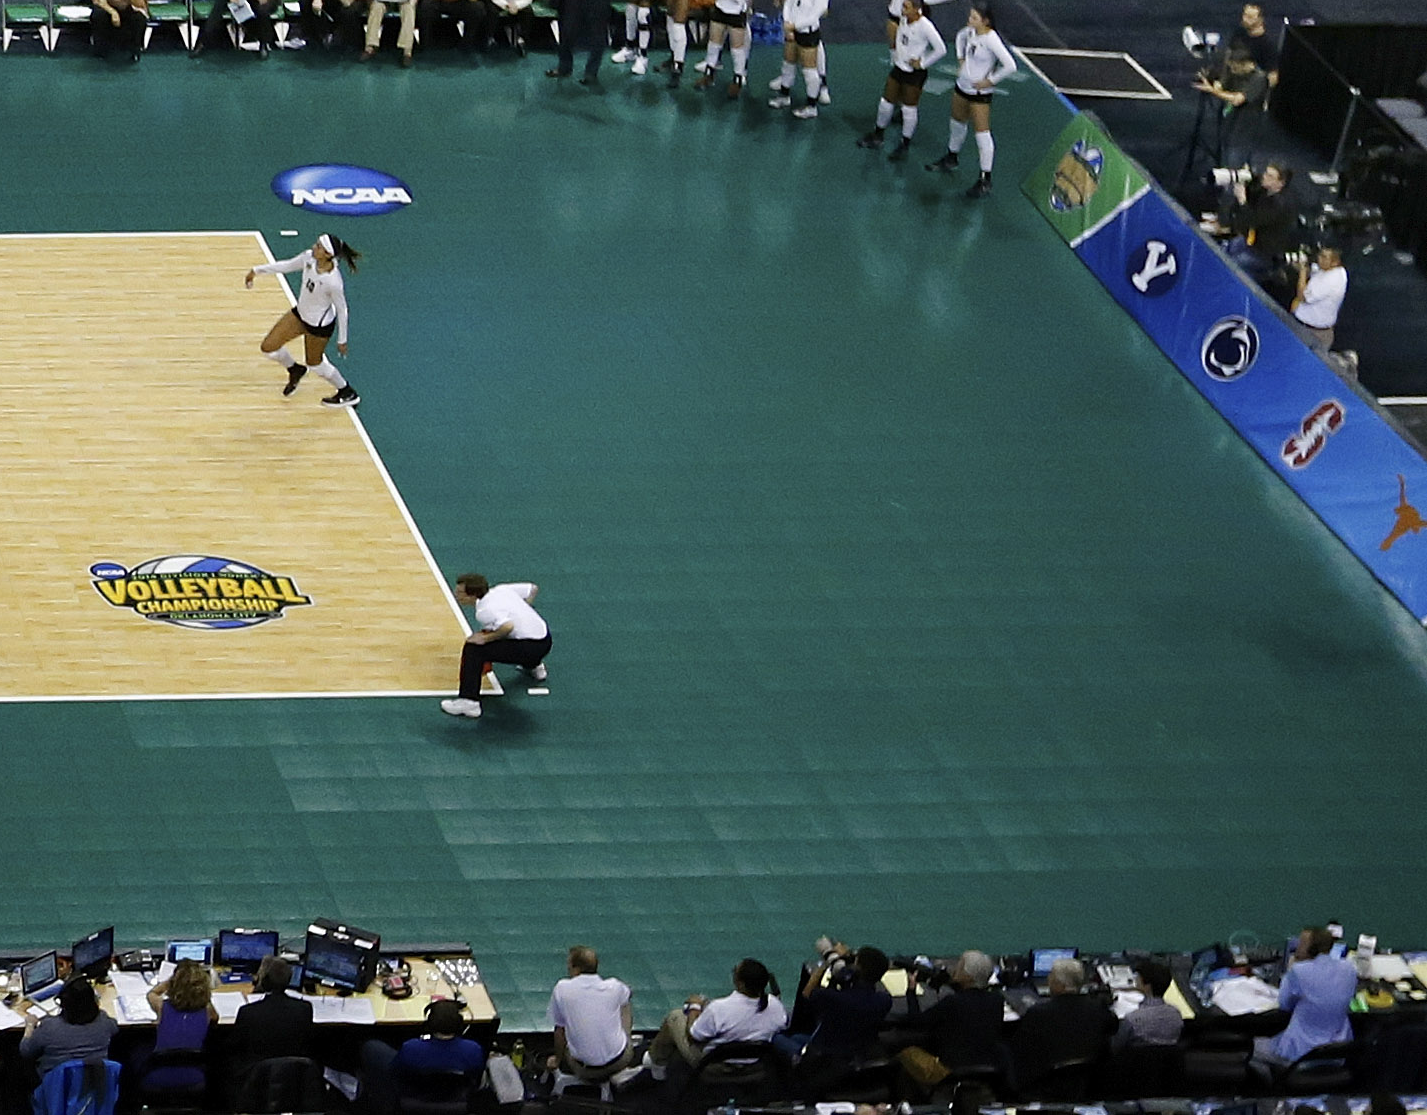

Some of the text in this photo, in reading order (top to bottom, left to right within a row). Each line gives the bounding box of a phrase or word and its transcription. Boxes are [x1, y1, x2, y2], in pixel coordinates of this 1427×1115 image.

[290, 187, 413, 205] NCAA
[97, 569, 126, 577] NCAA
[97, 577, 308, 605] VOLLEYBALL
[136, 598, 280, 614] CHAMPIONSHIP
